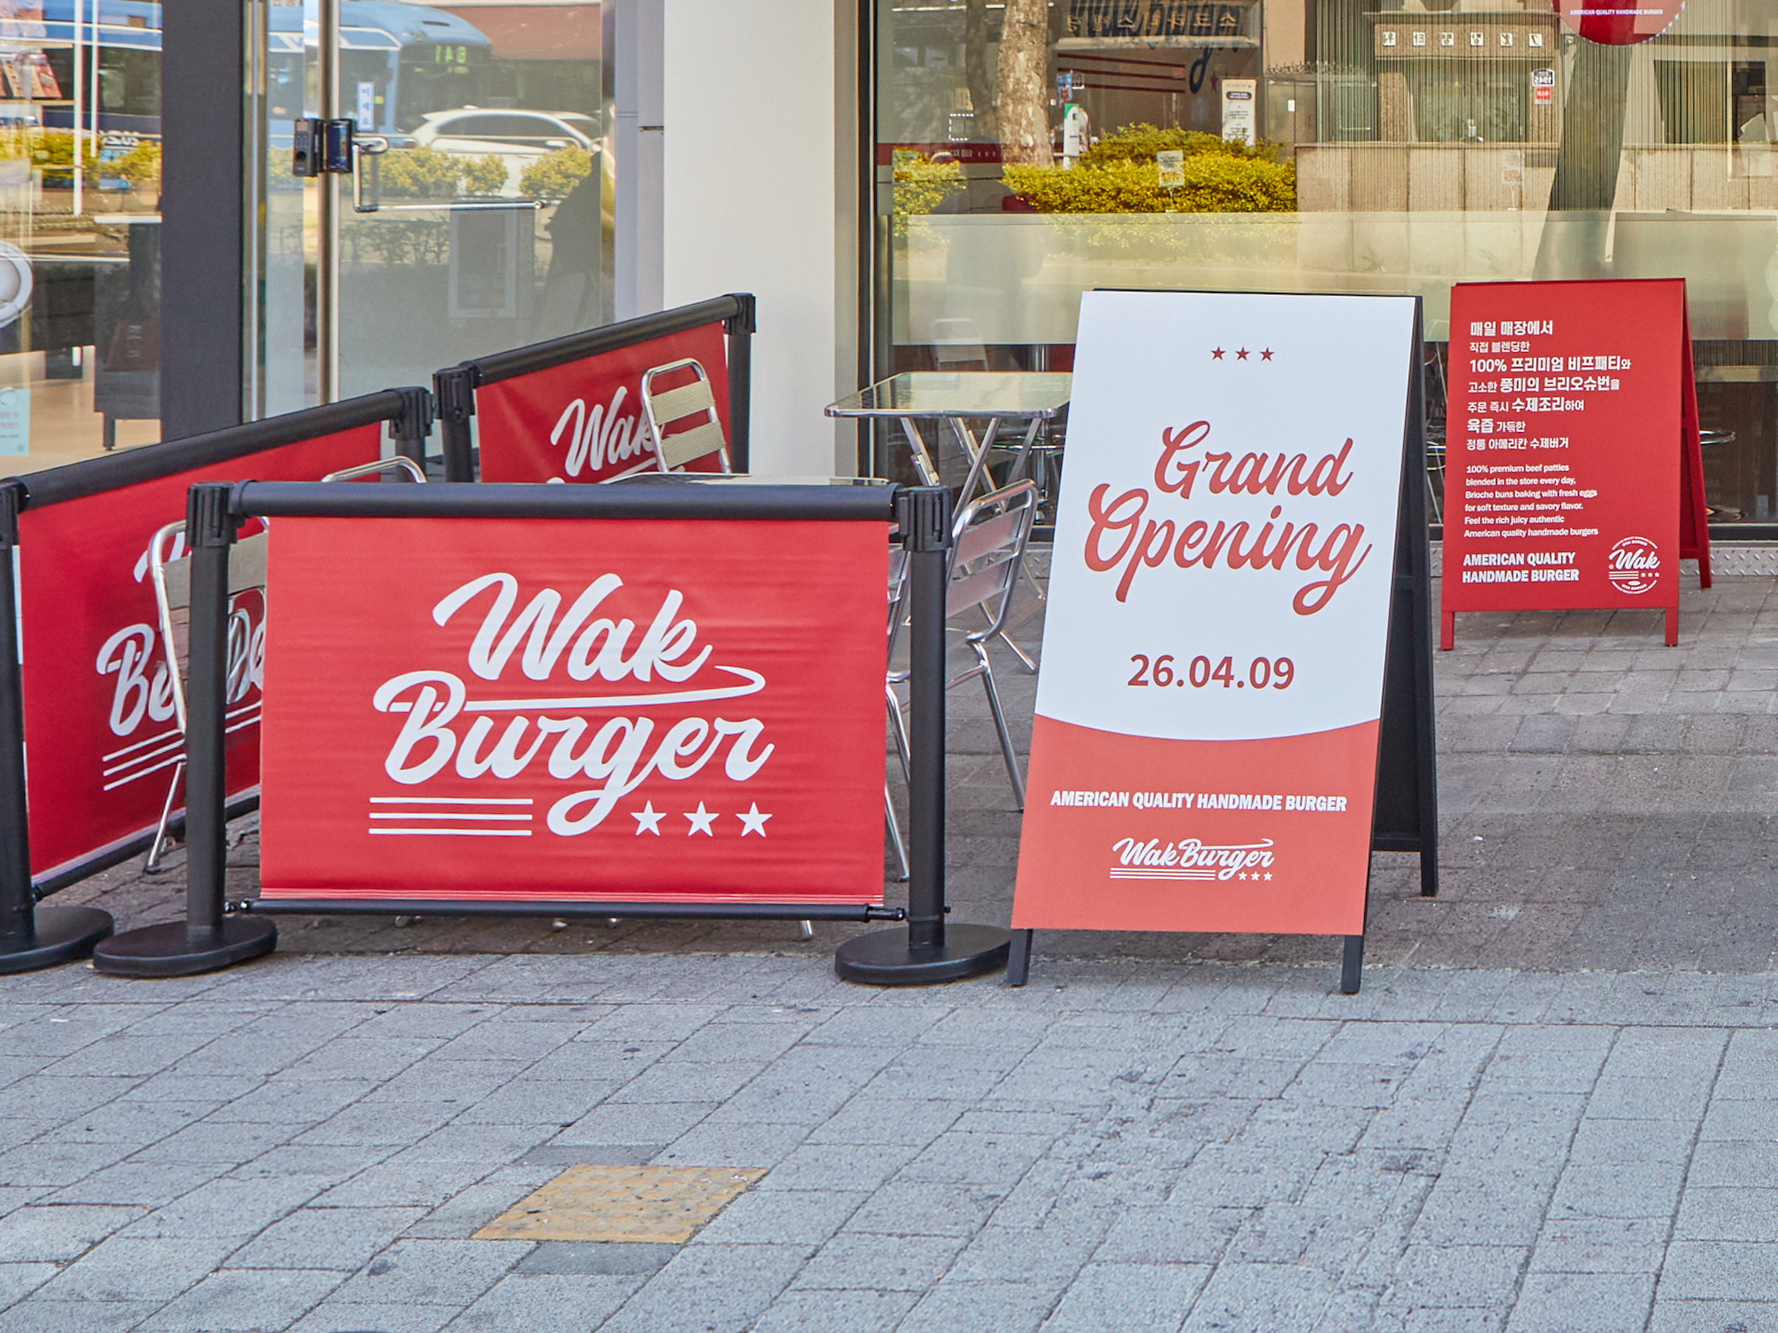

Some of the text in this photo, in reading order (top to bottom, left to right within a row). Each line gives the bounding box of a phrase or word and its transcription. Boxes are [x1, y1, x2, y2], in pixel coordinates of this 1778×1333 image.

[1471, 321, 1553, 337] 매일 매장에서
[1469, 341, 1530, 353] 직접 블렌딩한
[1469, 356, 1631, 373] 100% 프리미엄 비프패티와
[1468, 376, 1620, 394] 고소한 풍미의 브리오슈번을
[1468, 397, 1585, 414] 주문 즉시 수제조리하여
[1467, 419, 1493, 434] 육즙
[1467, 437, 1569, 451] 정통 아메리칸 수제버거
[1153, 420, 1354, 498] Grand
[1467, 464, 1569, 475] 100% premium beef patties
[1466, 477, 1577, 488] blended in the store every day,
[1465, 489, 1598, 500] Brioche buns baking with fresh eggs
[1465, 502, 1584, 513] for soft texture and savory flavor.
[1464, 515, 1564, 525] Feel the rich juicy authentic
[1464, 527, 1598, 539] American quality handmade burgers
[1083, 482, 1373, 616] Opening
[1463, 551, 1576, 566] AMERICAN QUALITY
[1609, 548, 1660, 570] Wak
[1462, 568, 1579, 583] HANDMADE BURGER
[432, 572, 714, 683] Wak
[1127, 653, 1295, 690] 26.04.09
[372, 670, 776, 838] Burger
[1050, 789, 1347, 812] AMERICAN QUALITY HANDMADE BURGER
[1112, 837, 1274, 880] Wak Burger
